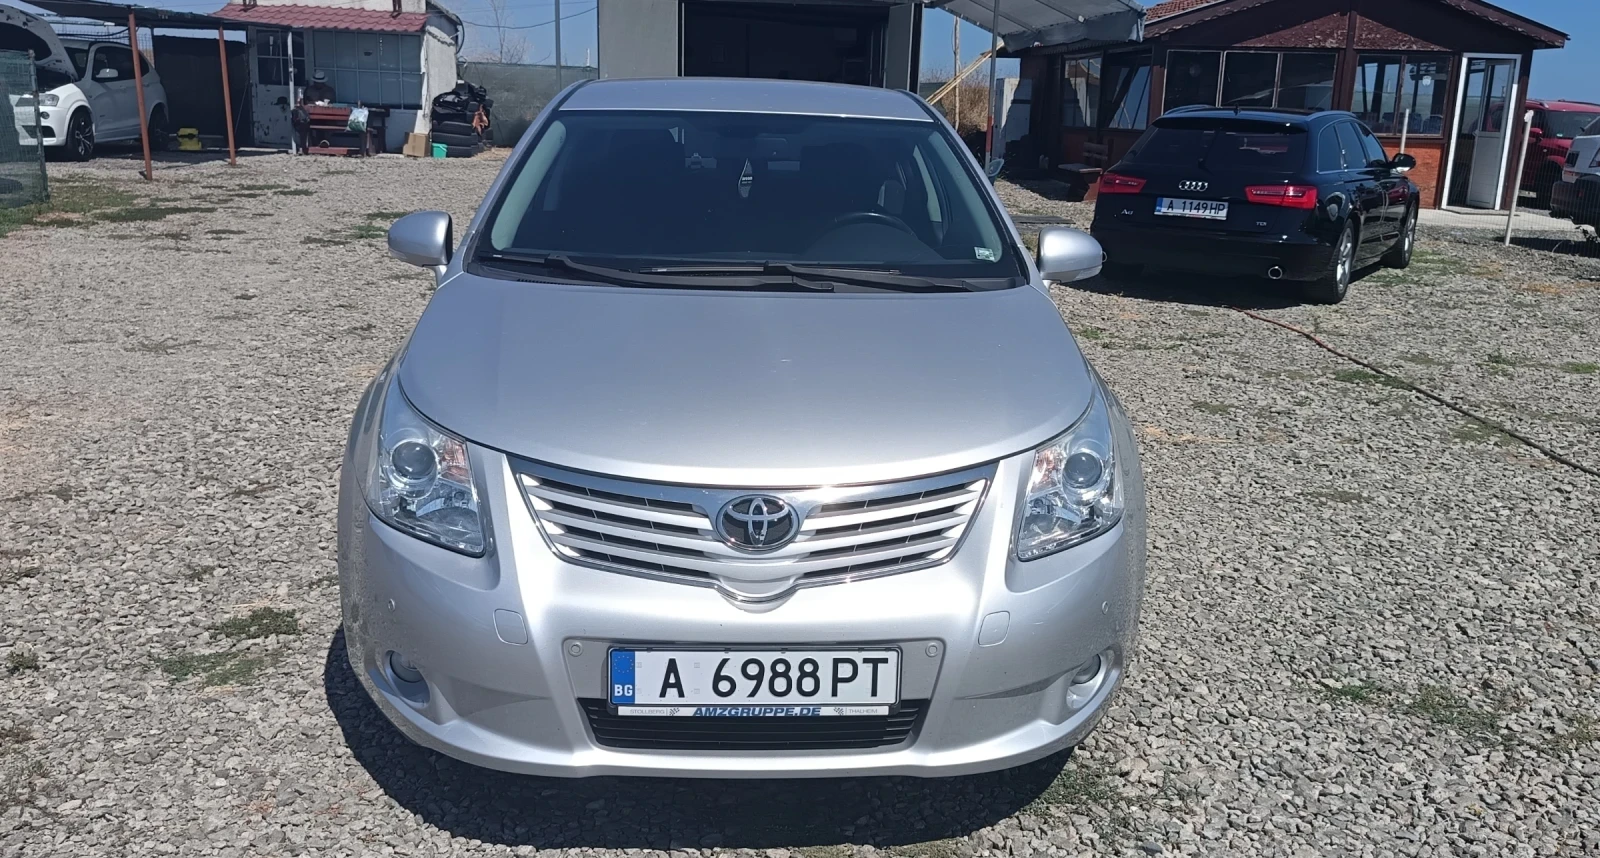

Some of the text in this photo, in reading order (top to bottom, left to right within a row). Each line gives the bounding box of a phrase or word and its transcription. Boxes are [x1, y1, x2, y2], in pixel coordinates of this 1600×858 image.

[1167, 200, 1174, 211] A
[658, 657, 889, 698] A 6988 PT
[613, 684, 633, 697] BG
[692, 706, 821, 717] AMZGRUPPE.DE
